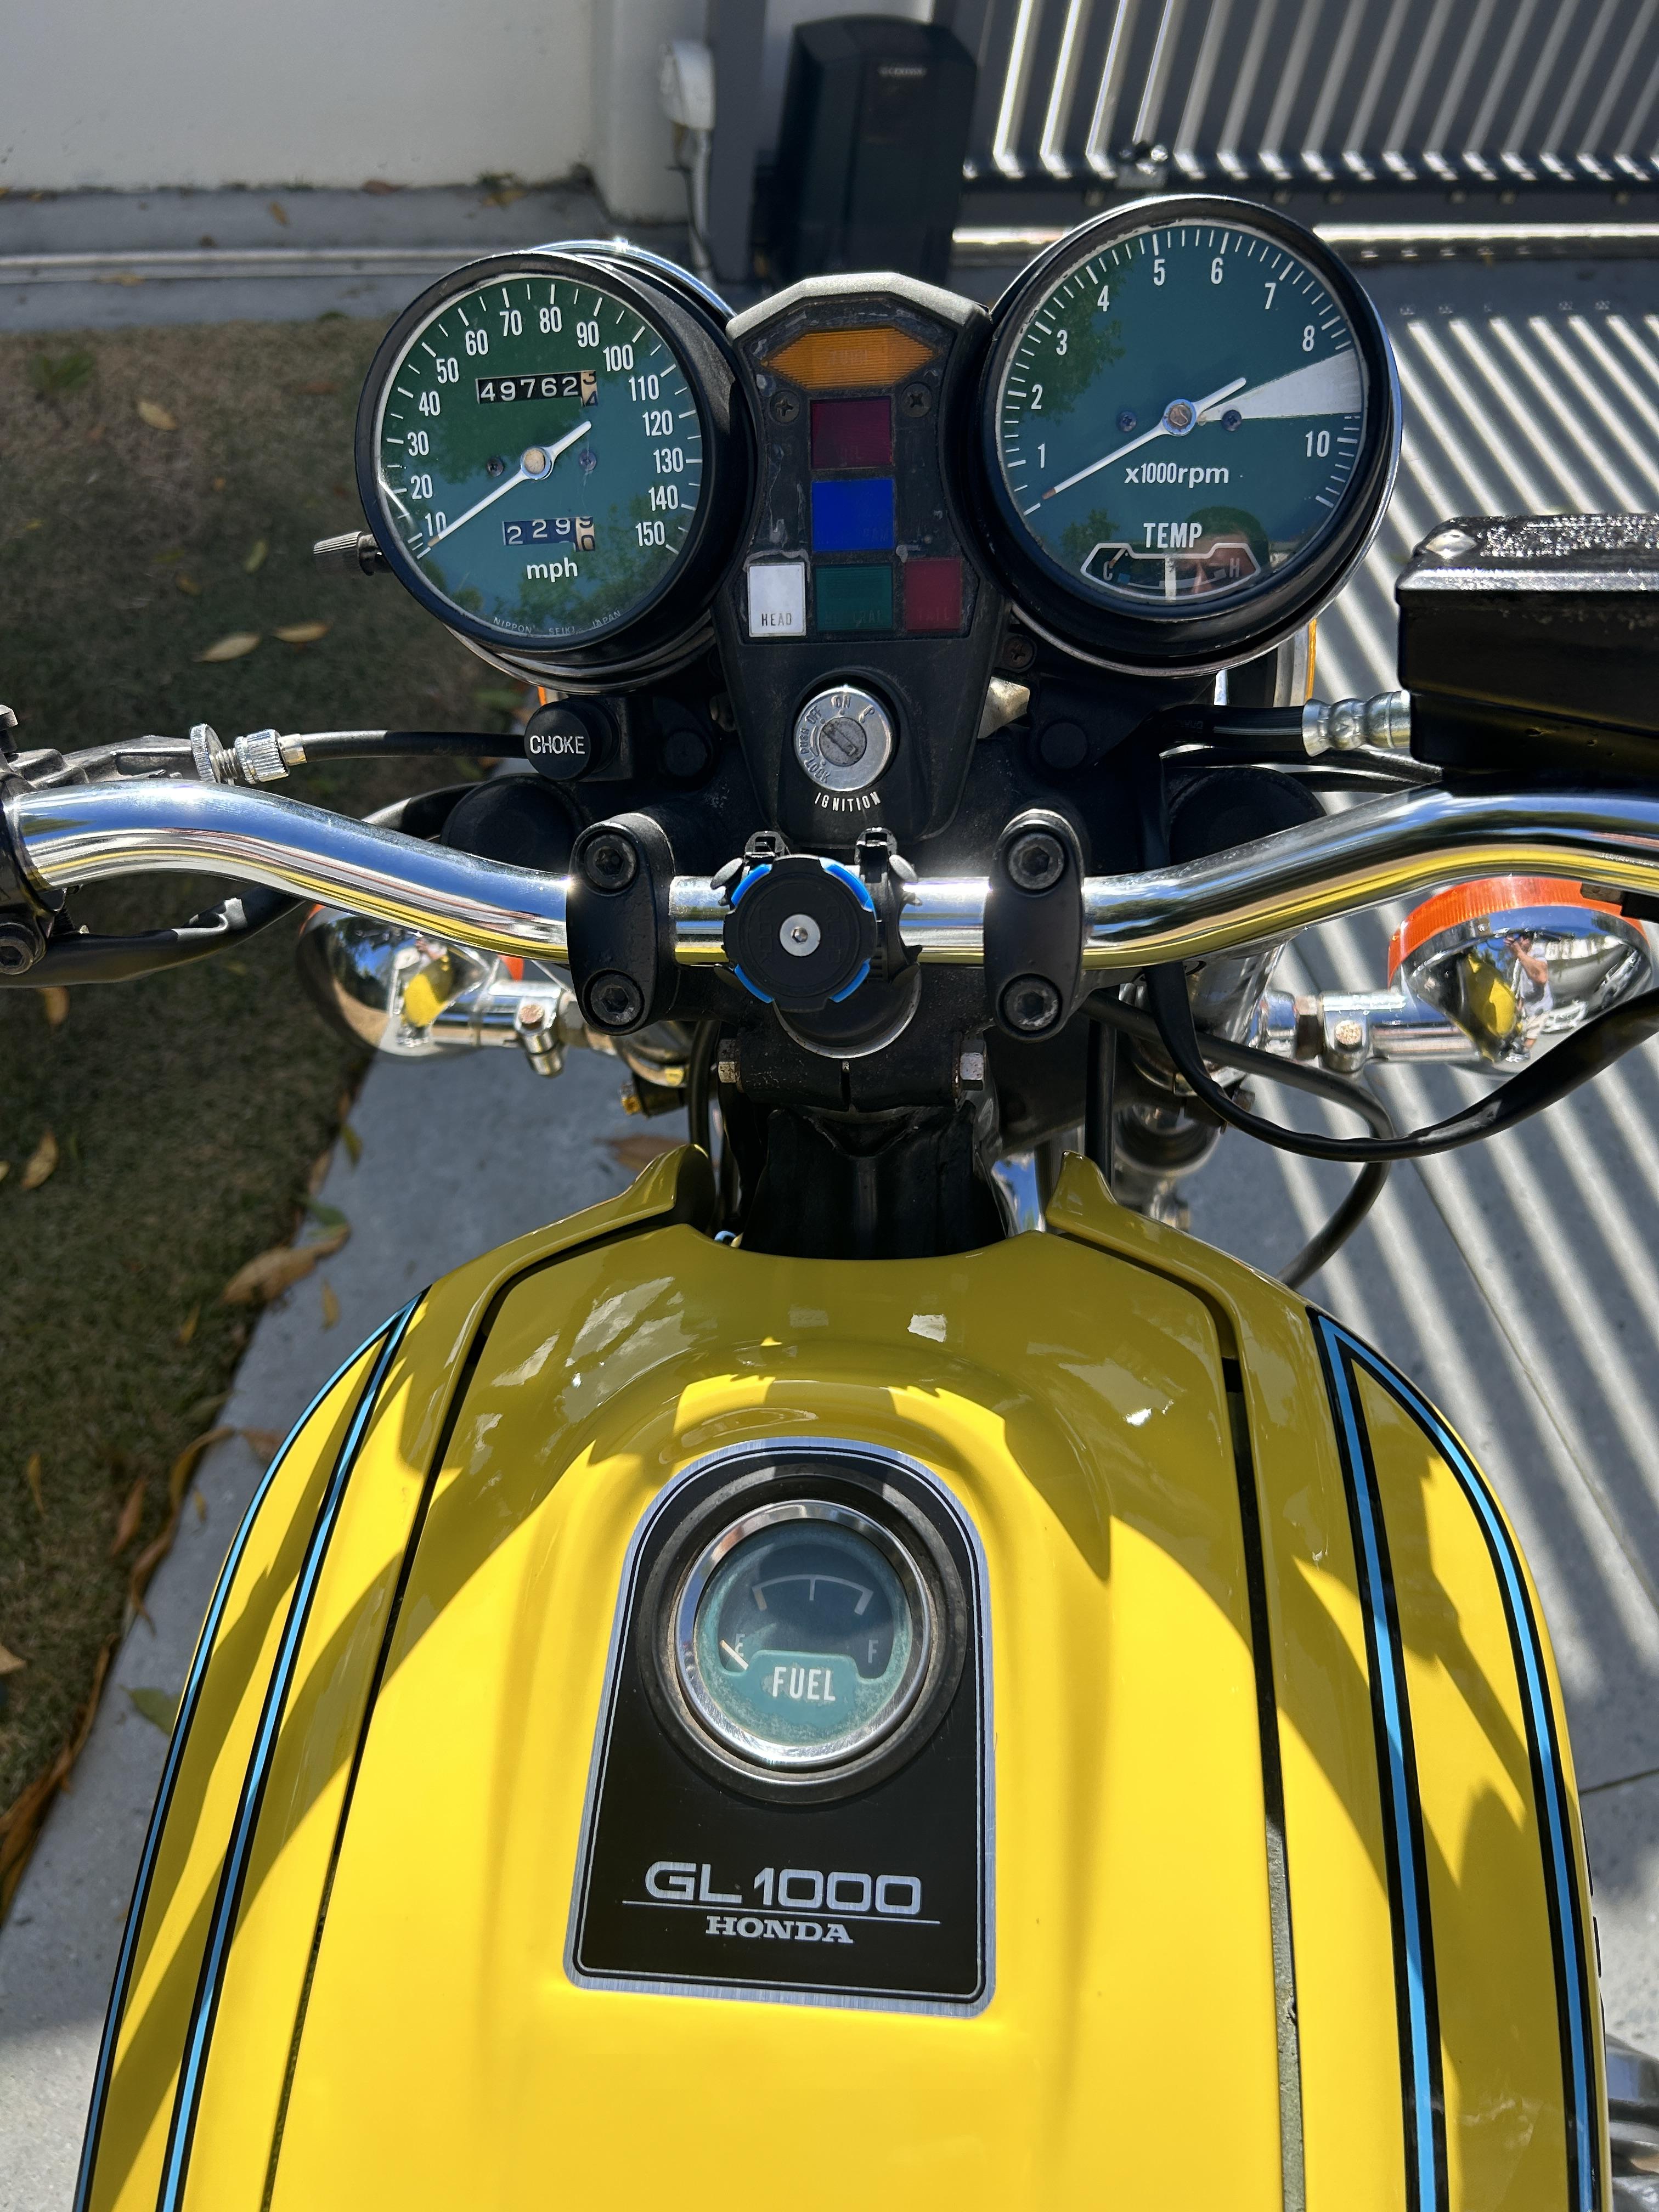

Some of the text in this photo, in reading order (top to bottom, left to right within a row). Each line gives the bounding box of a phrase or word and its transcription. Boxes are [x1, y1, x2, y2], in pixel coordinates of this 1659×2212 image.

[1154, 259, 1165, 285] 5
[1211, 257, 1223, 284] 6
[1098, 285, 1109, 312] 4
[1265, 283, 1276, 309] 7
[500, 310, 522, 336] 70
[540, 307, 562, 333] 80
[466, 330, 488, 356] 60
[577, 321, 599, 347] 90
[1057, 330, 1067, 355] 3
[1302, 325, 1314, 351] 8
[436, 358, 459, 383] 50
[603, 345, 633, 371] 100
[629, 375, 659, 400] 110
[1031, 385, 1042, 409] 2
[419, 391, 440, 416] 40
[643, 409, 673, 436] 120
[408, 431, 428, 456] 30
[1038, 444, 1045, 468] 1
[1306, 431, 1329, 456] 10
[653, 447, 683, 473] 130
[411, 475, 432, 499] 20
[1125, 462, 1229, 488] x1000rpm
[648, 484, 678, 511] 140
[425, 511, 448, 537] 10
[635, 521, 664, 546] 150
[1144, 523, 1201, 548] TEMP
[527, 557, 577, 582] mph
[1229, 557, 1240, 578] H
[493, 617, 533, 634] NIPPON
[591, 610, 622, 628] JAPAN
[761, 612, 792, 627] HEAD
[831, 695, 850, 709] ON
[804, 705, 822, 725] OFF
[530, 735, 585, 754] CHOKE
[804, 758, 831, 783] LOCK
[815, 791, 881, 812] IGNITION
[867, 1639, 879, 1664] F
[772, 1667, 835, 1701] FUEL
[645, 1860, 922, 1915] GL 1000
[706, 1915, 854, 1944] HONDA
